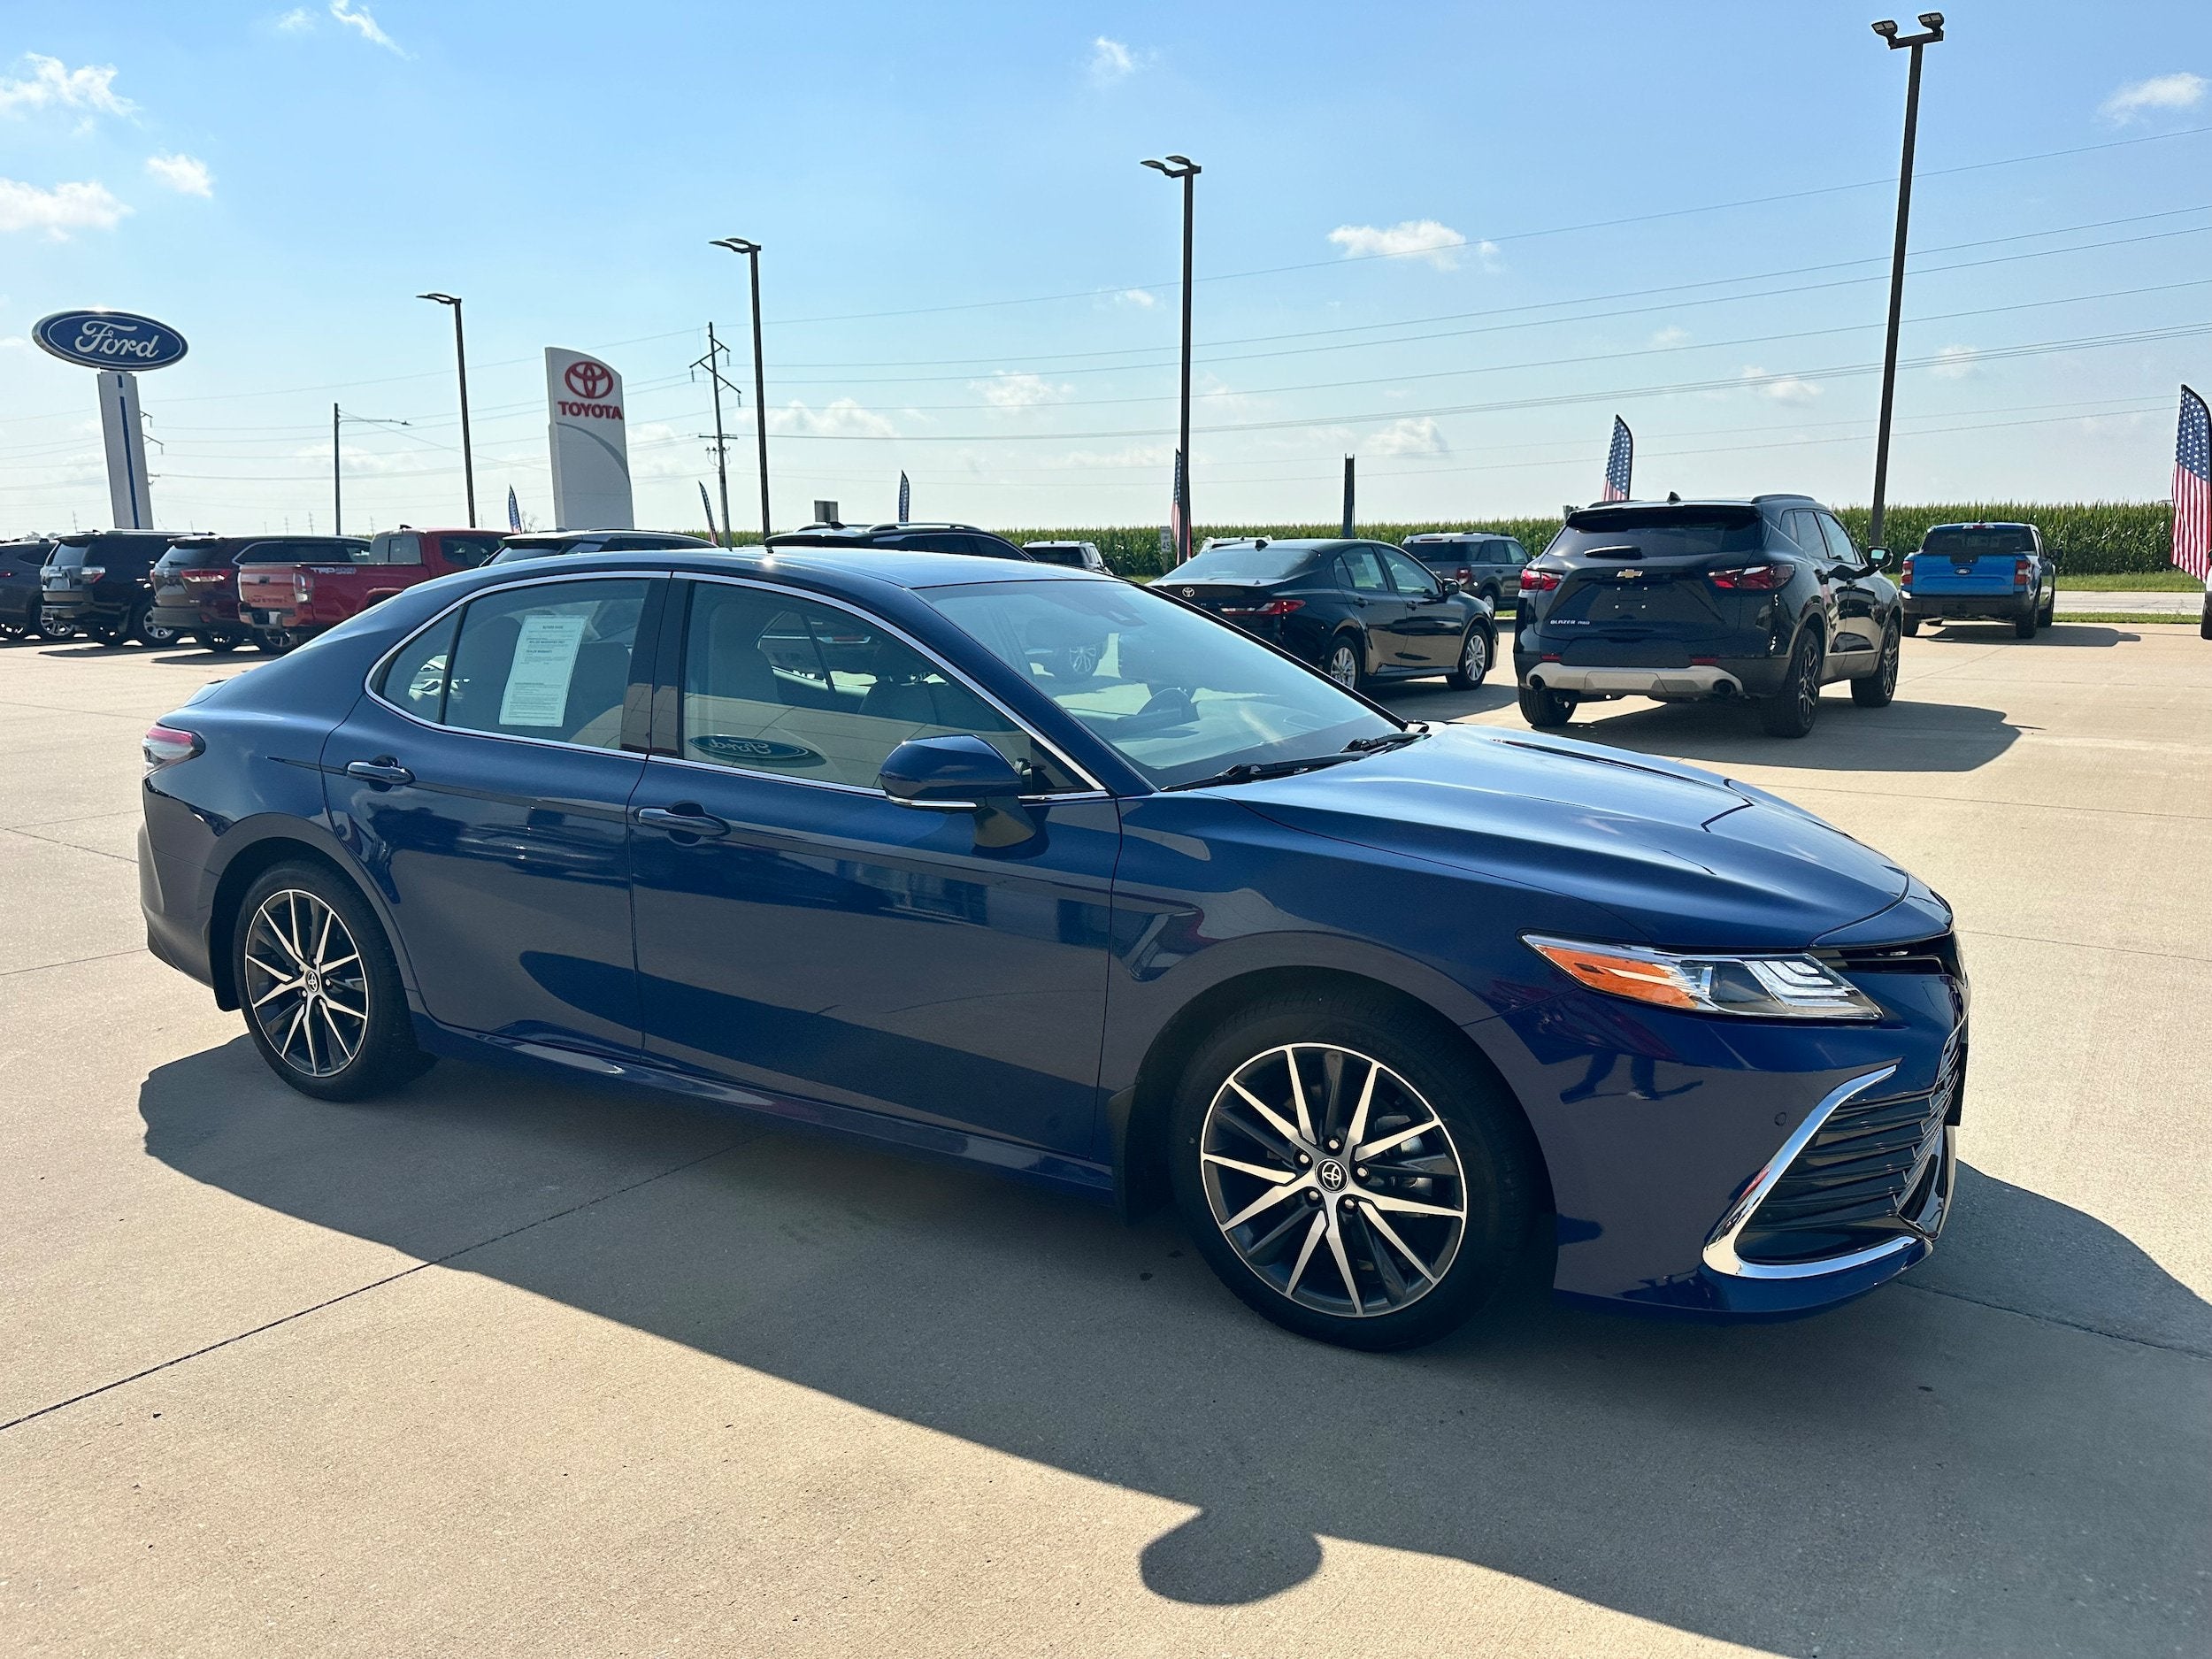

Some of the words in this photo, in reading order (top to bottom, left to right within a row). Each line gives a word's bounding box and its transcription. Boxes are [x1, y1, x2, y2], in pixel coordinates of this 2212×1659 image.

[74, 320, 159, 358] Ford
[557, 401, 624, 420] TOYOTA
[1161, 541, 1171, 550] 45
